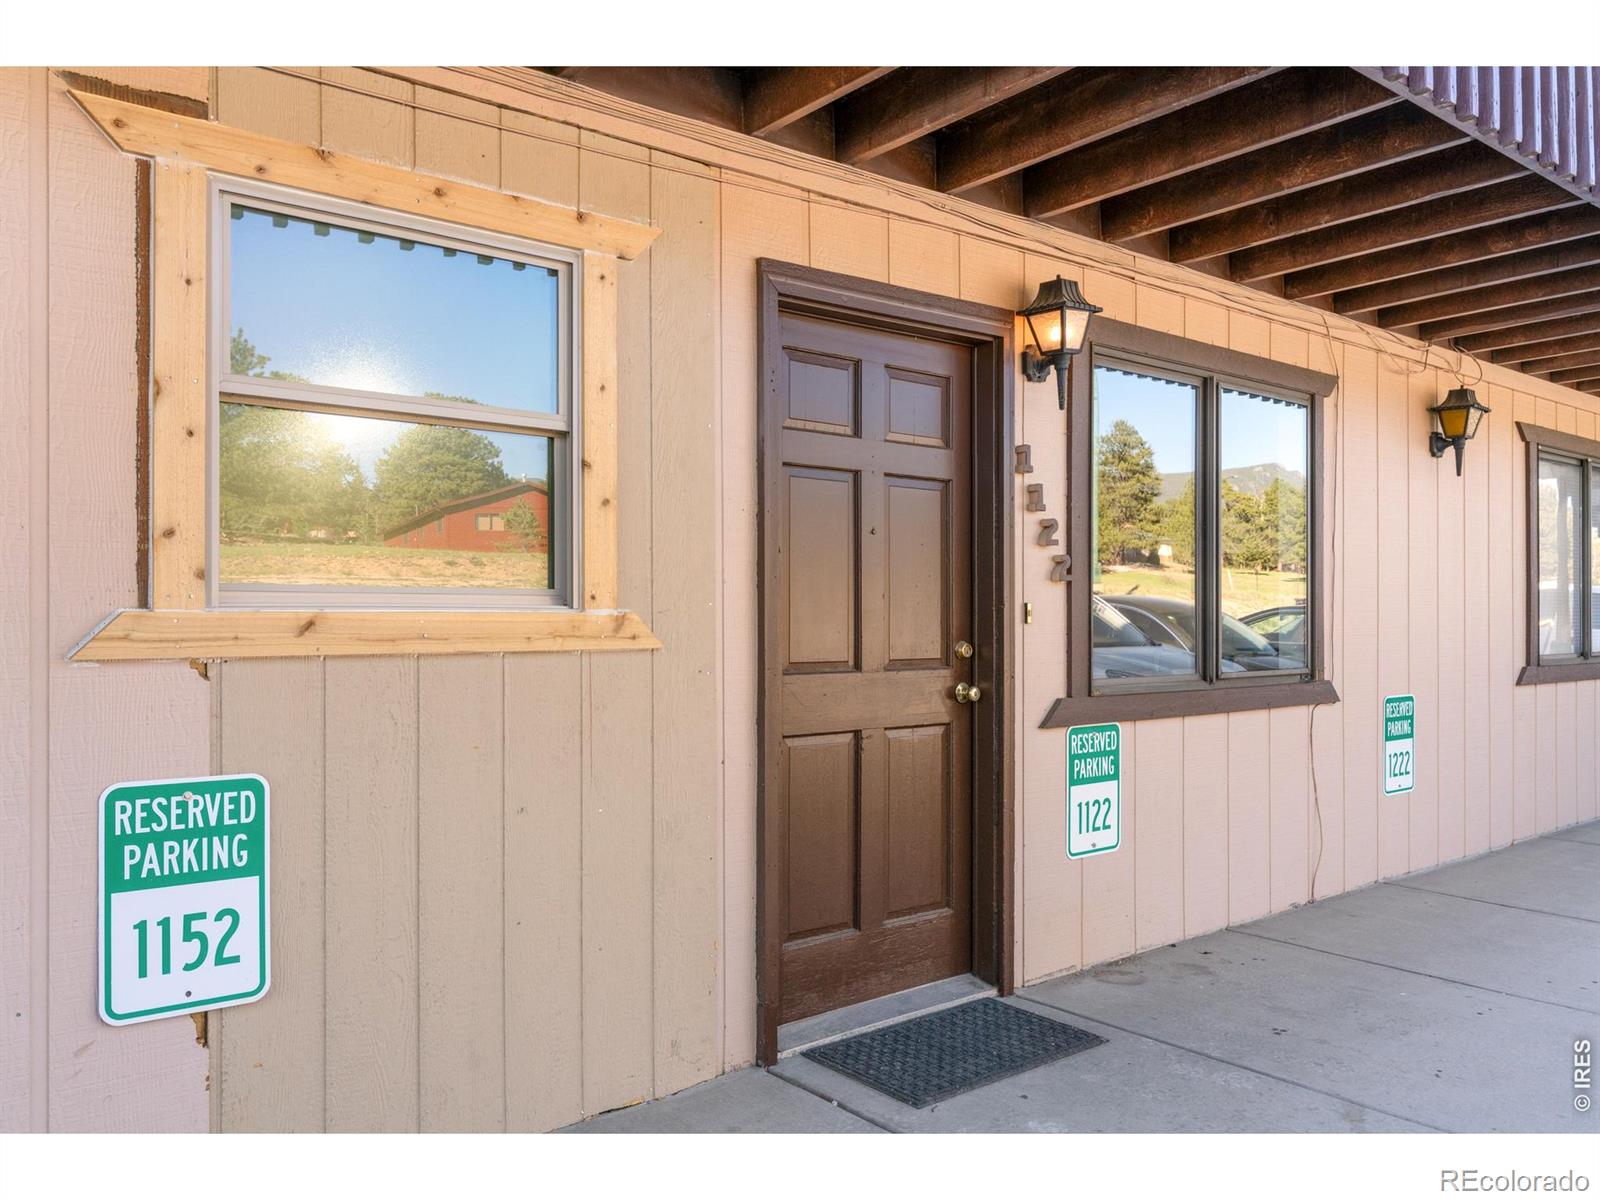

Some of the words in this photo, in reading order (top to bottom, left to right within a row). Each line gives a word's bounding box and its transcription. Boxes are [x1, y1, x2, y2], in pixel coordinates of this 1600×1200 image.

[1386, 701, 1413, 718] RESERVED
[1387, 719, 1412, 737] PARKING
[1071, 731, 1117, 755] RESERVED
[1073, 756, 1115, 780] PARKING
[1388, 751, 1411, 778] 1222
[114, 790, 256, 836] RESERVED
[1076, 797, 1112, 835] 1122
[123, 833, 249, 880] PARKING
[132, 907, 241, 979] 1152
